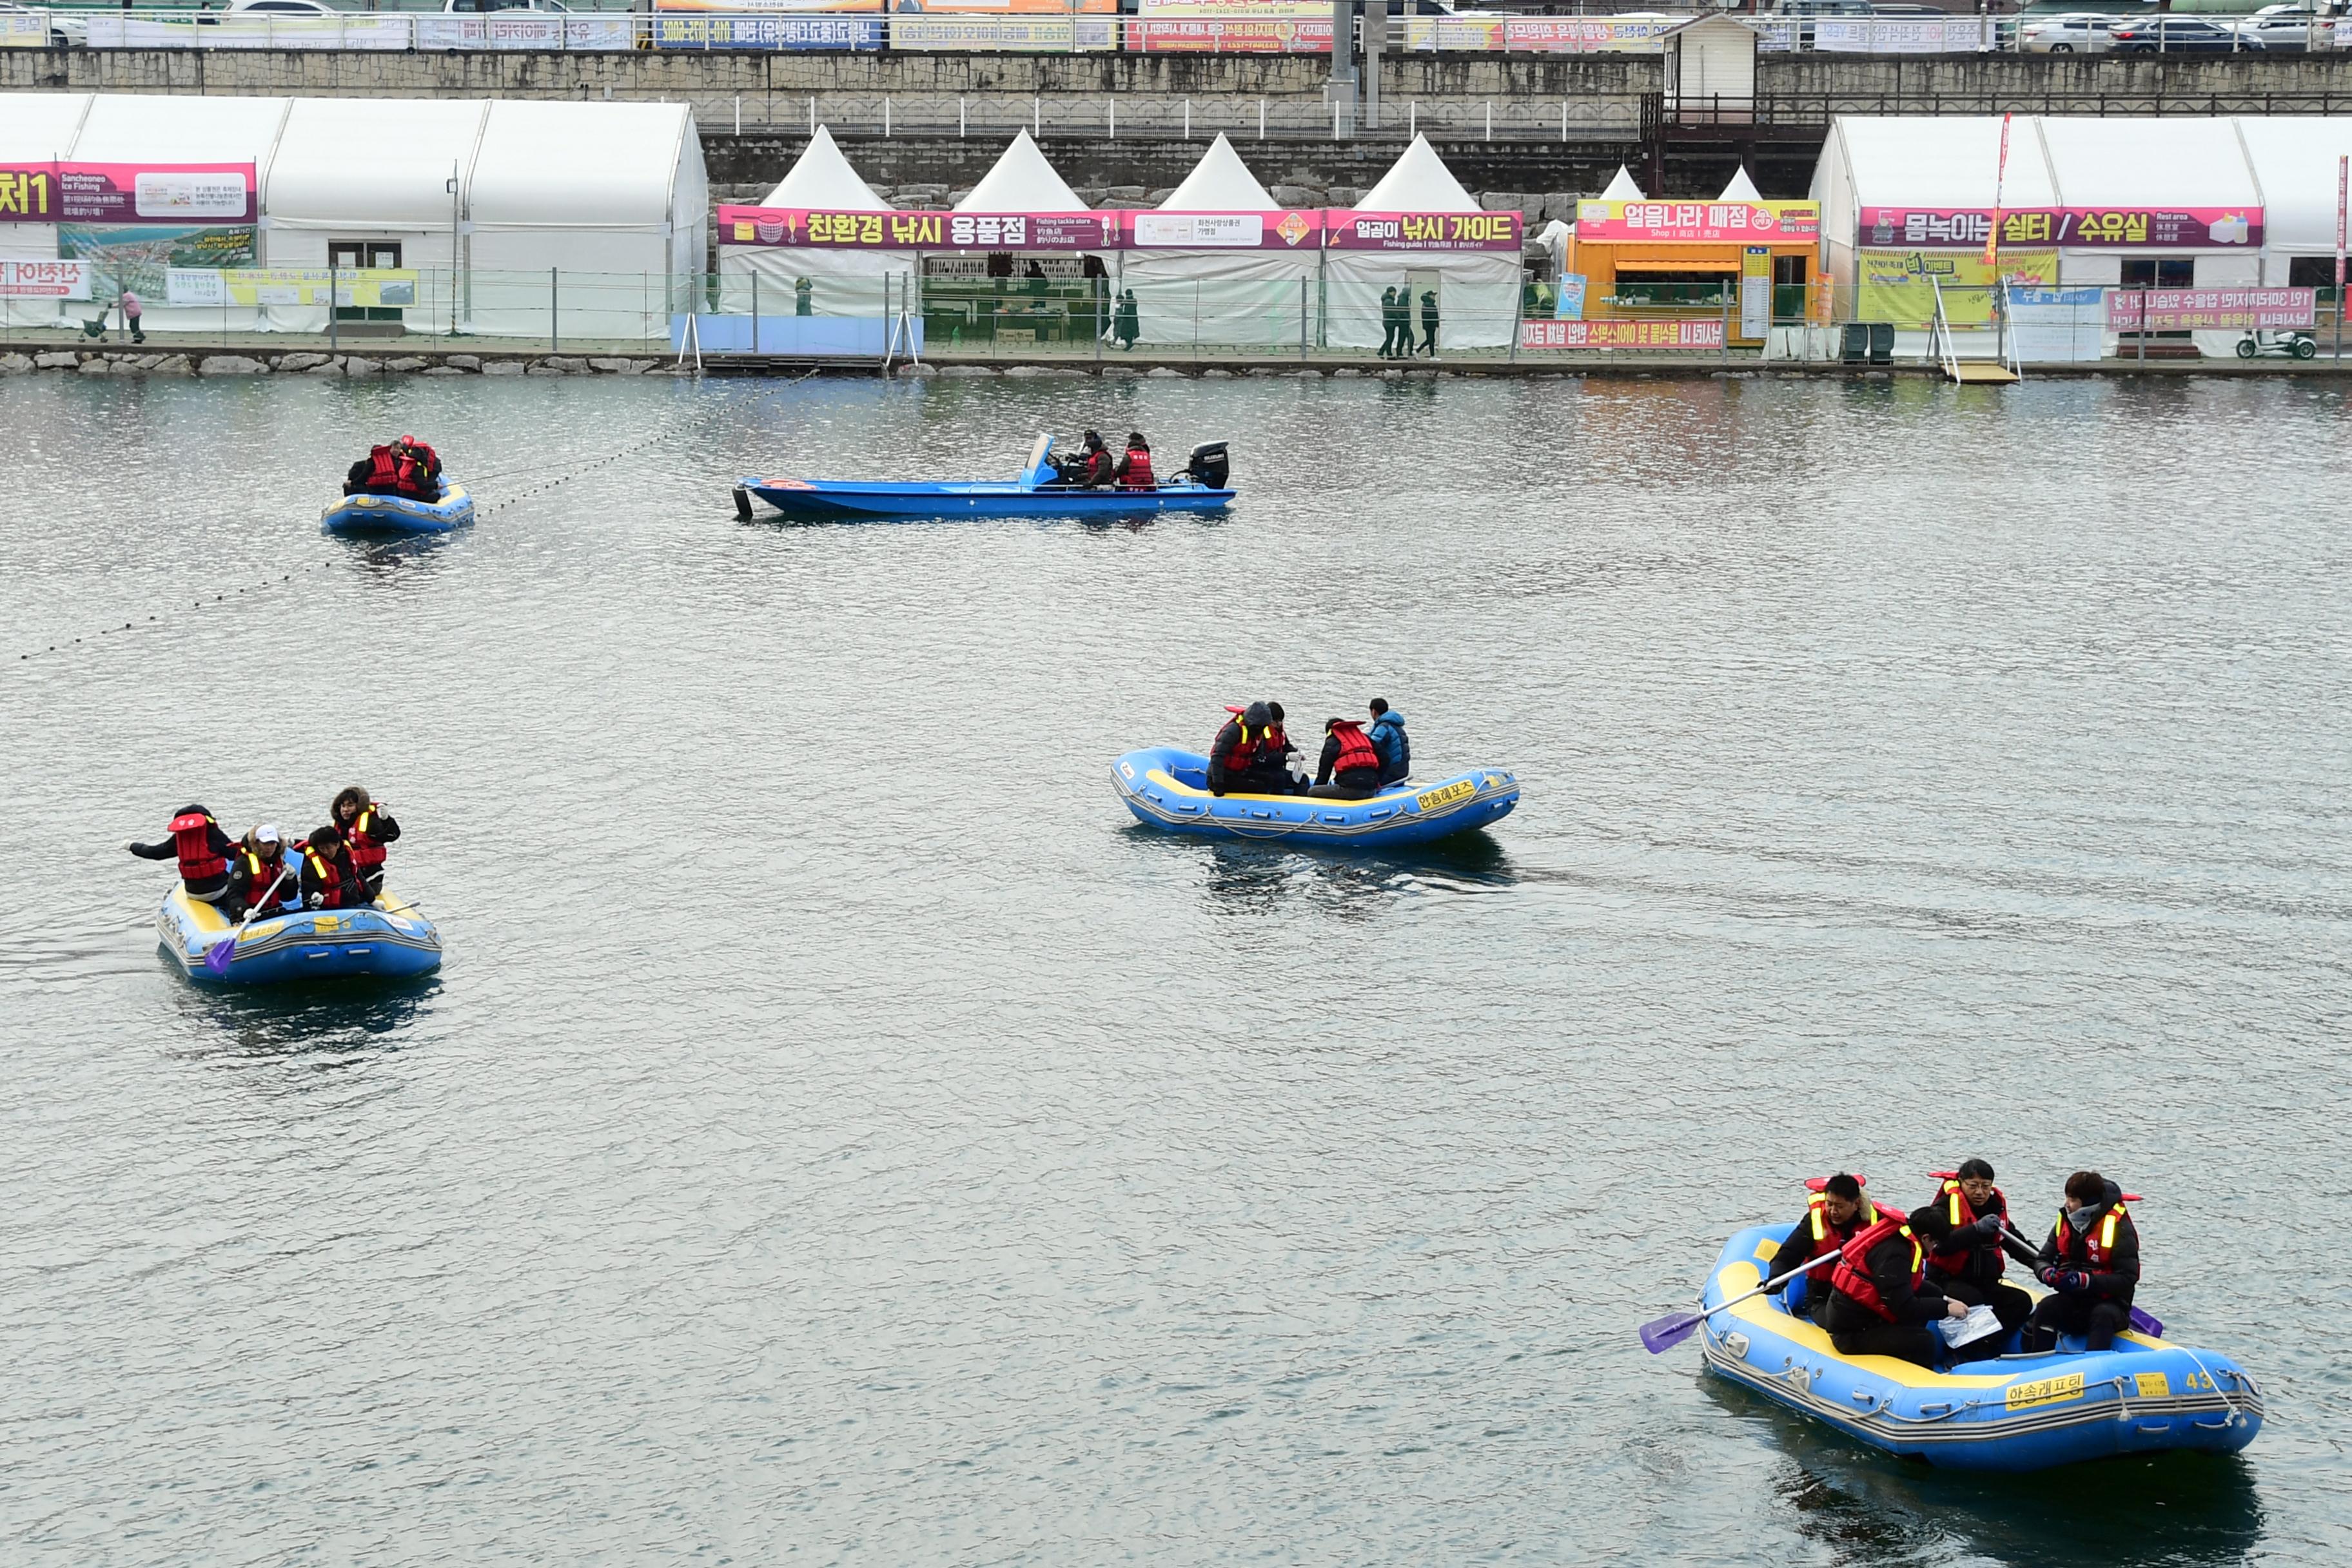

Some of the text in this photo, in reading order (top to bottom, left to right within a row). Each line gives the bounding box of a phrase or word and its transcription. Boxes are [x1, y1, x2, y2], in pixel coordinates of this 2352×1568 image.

[61, 174, 106, 182] Sancheoneo
[74, 182, 100, 192] Fishing
[1625, 205, 1747, 228] 얼음나라 매점
[807, 213, 1026, 244] 친환경 낚시 용품점
[1197, 219, 1240, 228] 화천사랑상품권
[1356, 216, 1513, 240] 얼곰이 낚시 가이드
[1905, 213, 1992, 242] 몸녹이는
[2004, 213, 2051, 241] 쉼터
[2077, 213, 2148, 242] 수유실
[1197, 228, 1216, 236] 가맹점
[1651, 229, 1669, 237] Shop
[1679, 230, 1694, 238] 商店
[1906, 257, 1921, 273] 빅
[1924, 260, 1954, 273] 이벤트
[2186, 1372, 2212, 1390] 43
